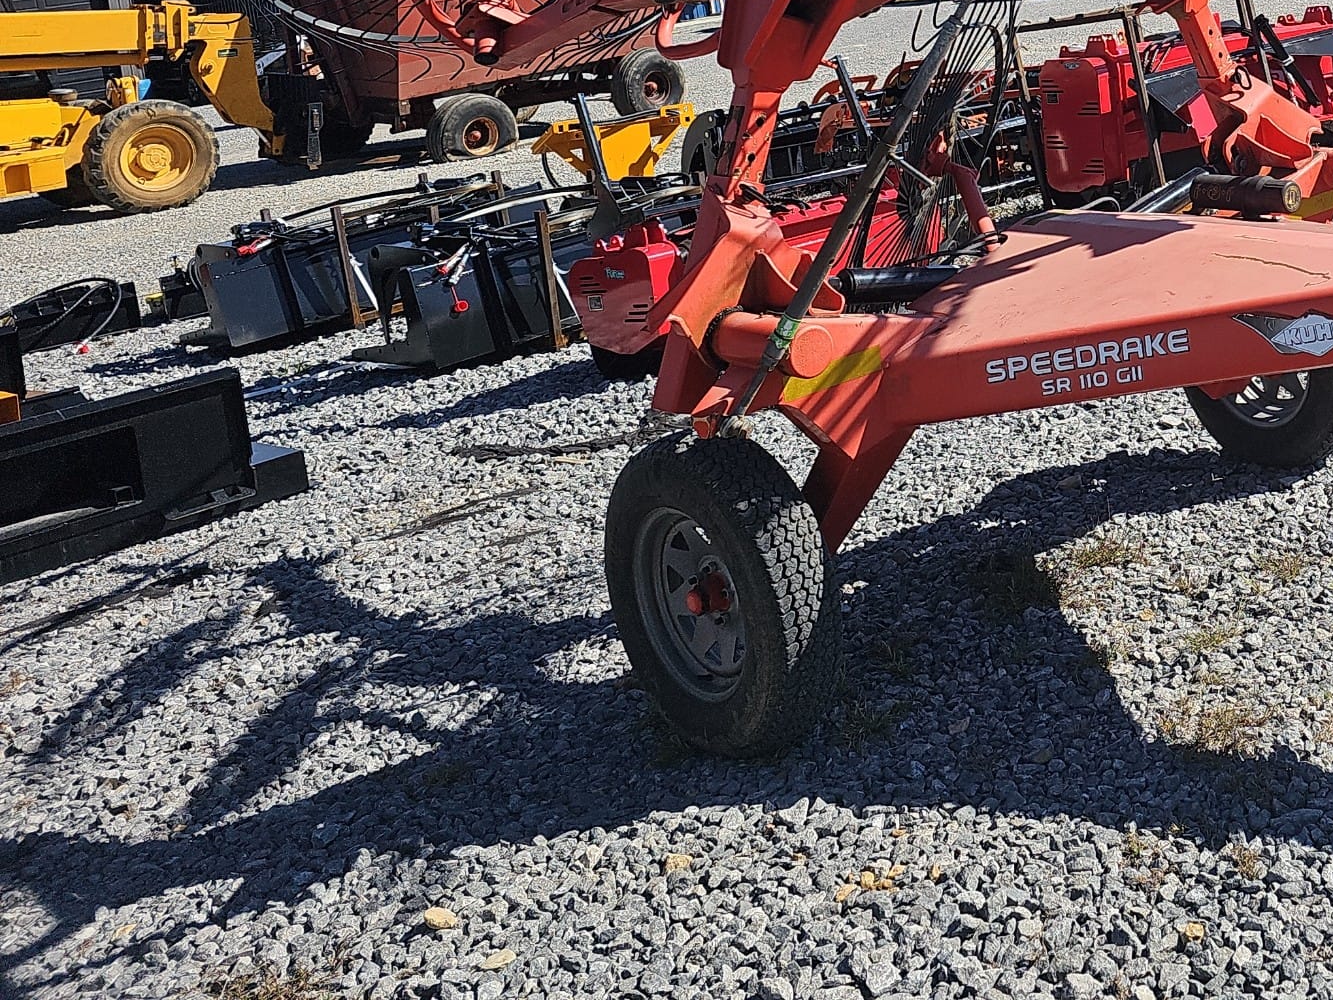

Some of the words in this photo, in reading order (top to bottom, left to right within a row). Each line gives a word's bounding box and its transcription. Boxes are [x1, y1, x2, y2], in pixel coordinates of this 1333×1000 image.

[985, 328, 1190, 384] SPEEDRAKE
[1041, 377, 1071, 396] SR
[1079, 371, 1109, 390] 110
[1116, 365, 1143, 384] GII
